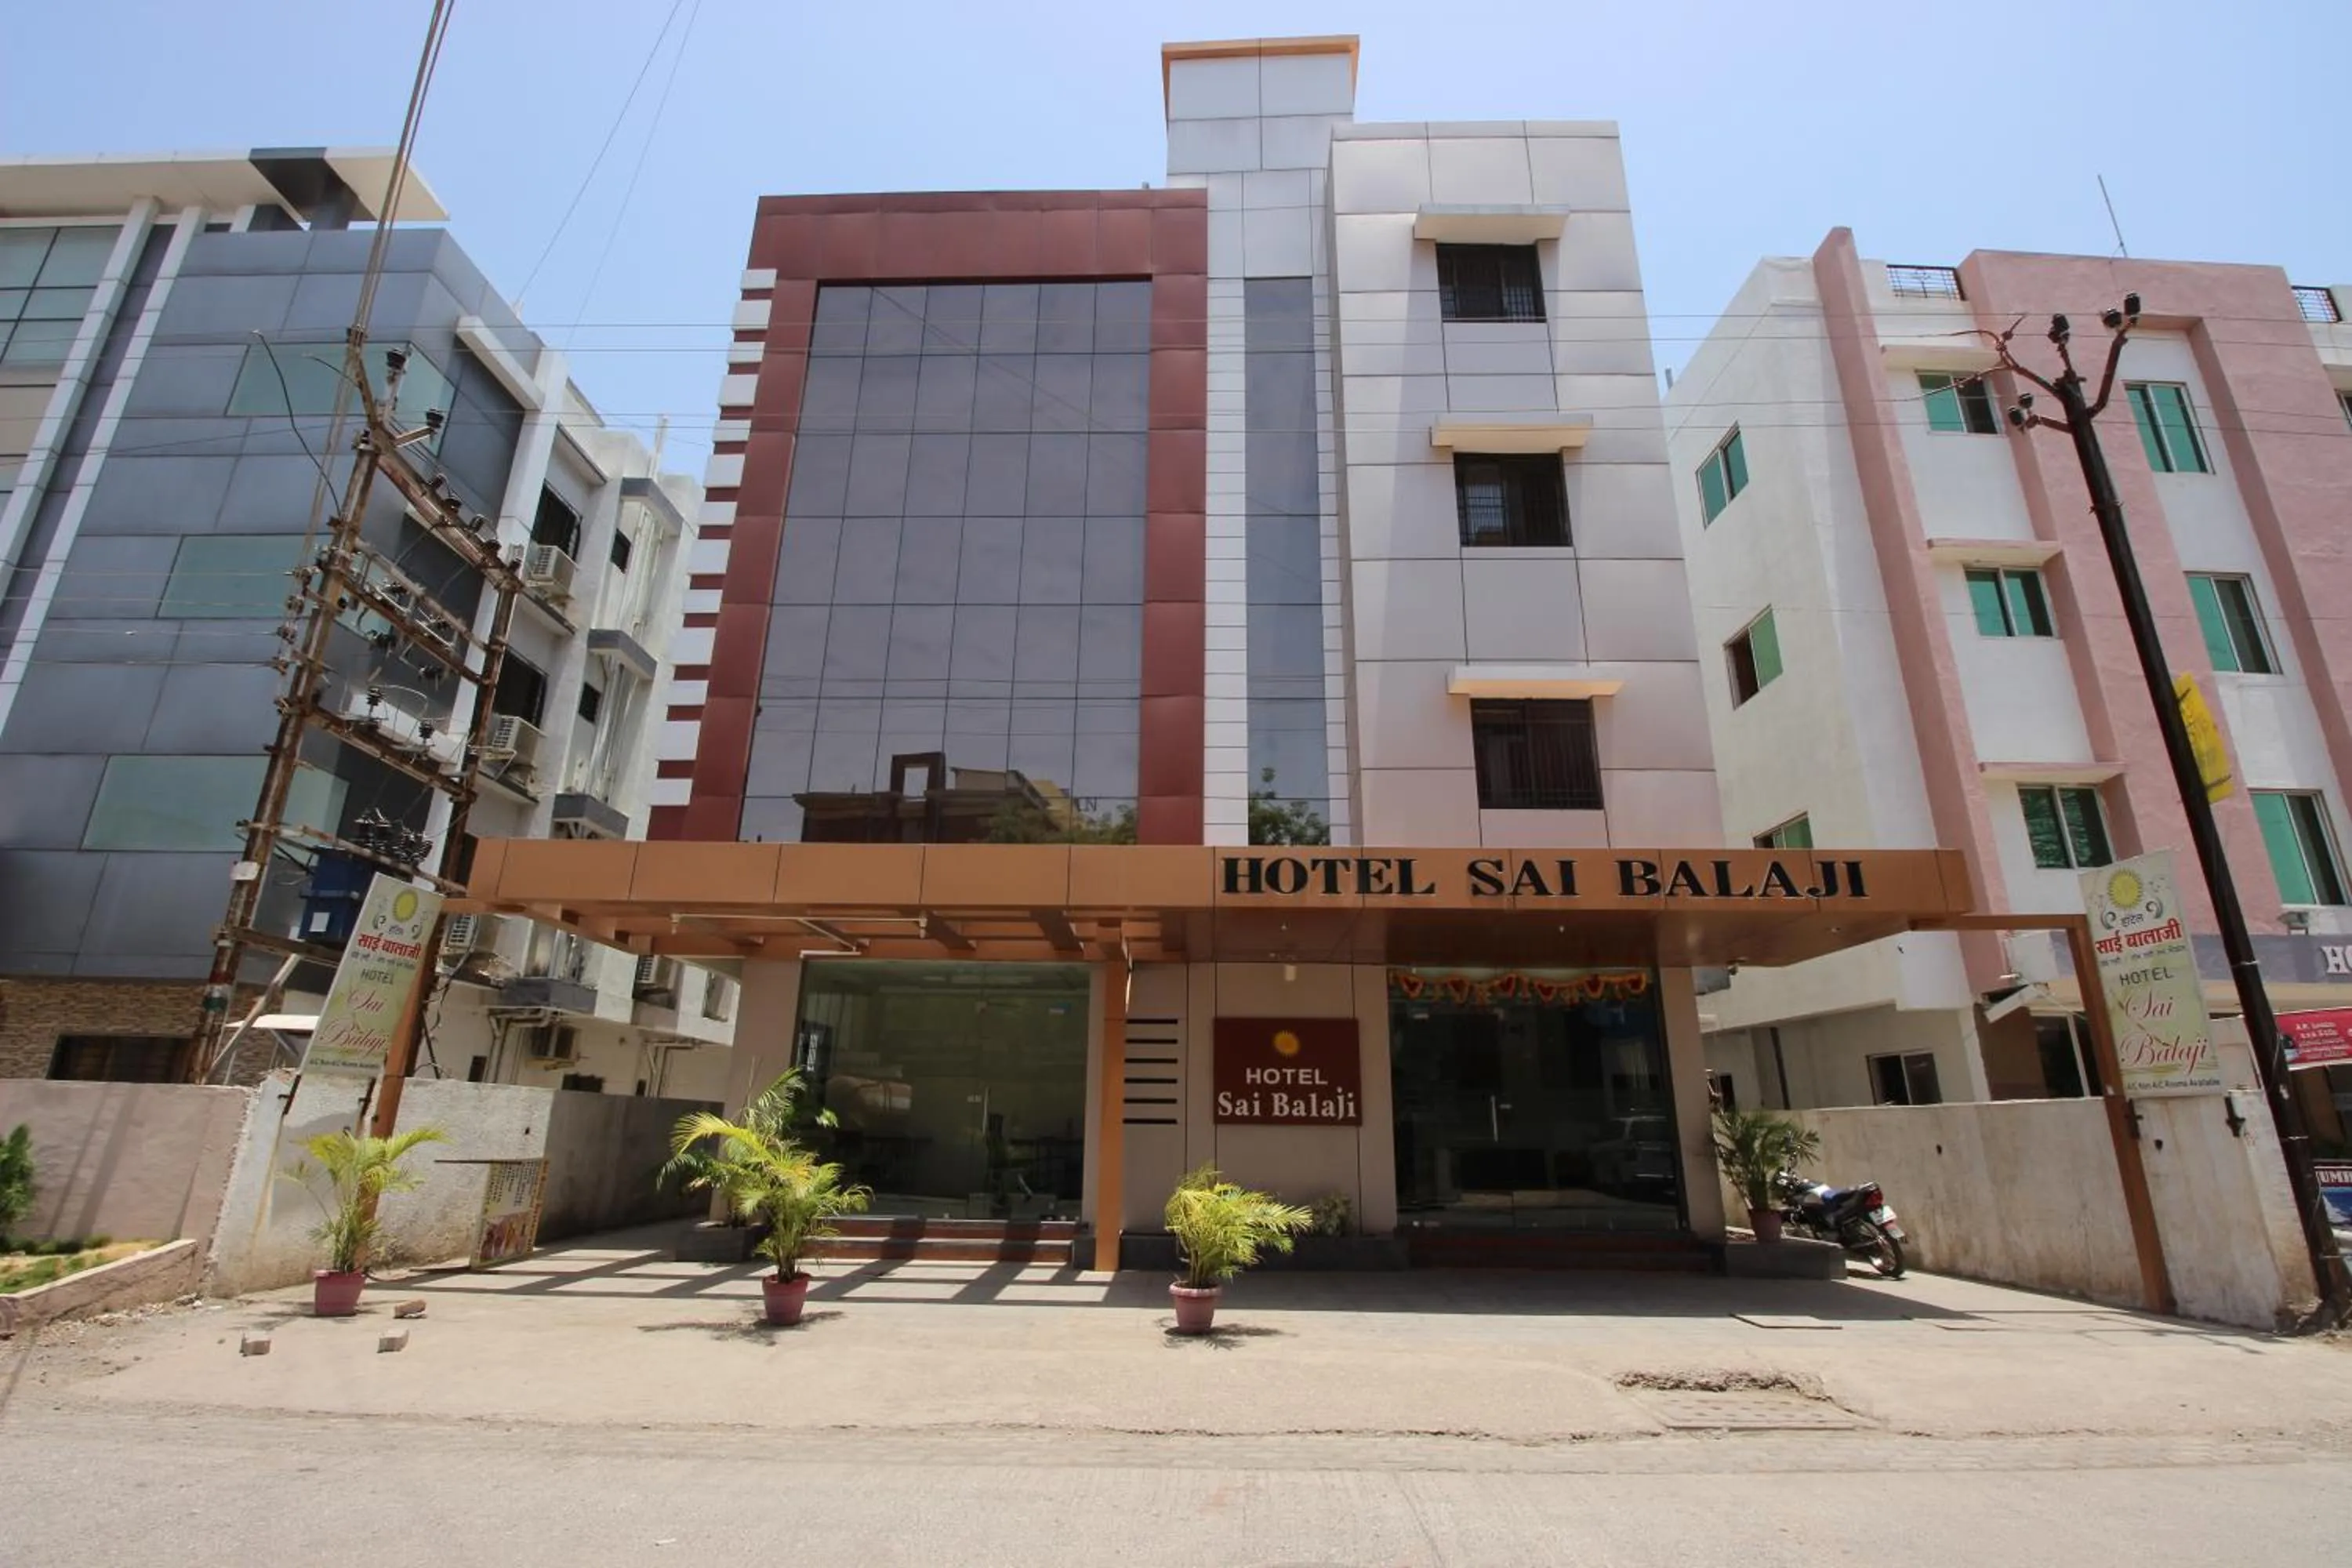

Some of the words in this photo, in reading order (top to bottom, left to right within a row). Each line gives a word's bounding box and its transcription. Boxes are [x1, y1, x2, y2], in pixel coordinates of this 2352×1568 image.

[1221, 857, 1436, 895] HOTEL
[1467, 859, 1580, 897] SAI
[1614, 859, 1871, 898] BALAJI
[2125, 918, 2182, 948] बालाजी
[361, 968, 394, 985] HOTEL
[2119, 966, 2175, 986] HOTEL
[347, 989, 387, 1012] Sai
[2123, 989, 2173, 1018] Sai
[319, 1018, 390, 1058] Balaji
[2119, 1031, 2208, 1076] Balaji
[1245, 1067, 1329, 1085] HOTEL
[1218, 1091, 1261, 1116] Sai
[1271, 1086, 1356, 1120] Balaji
